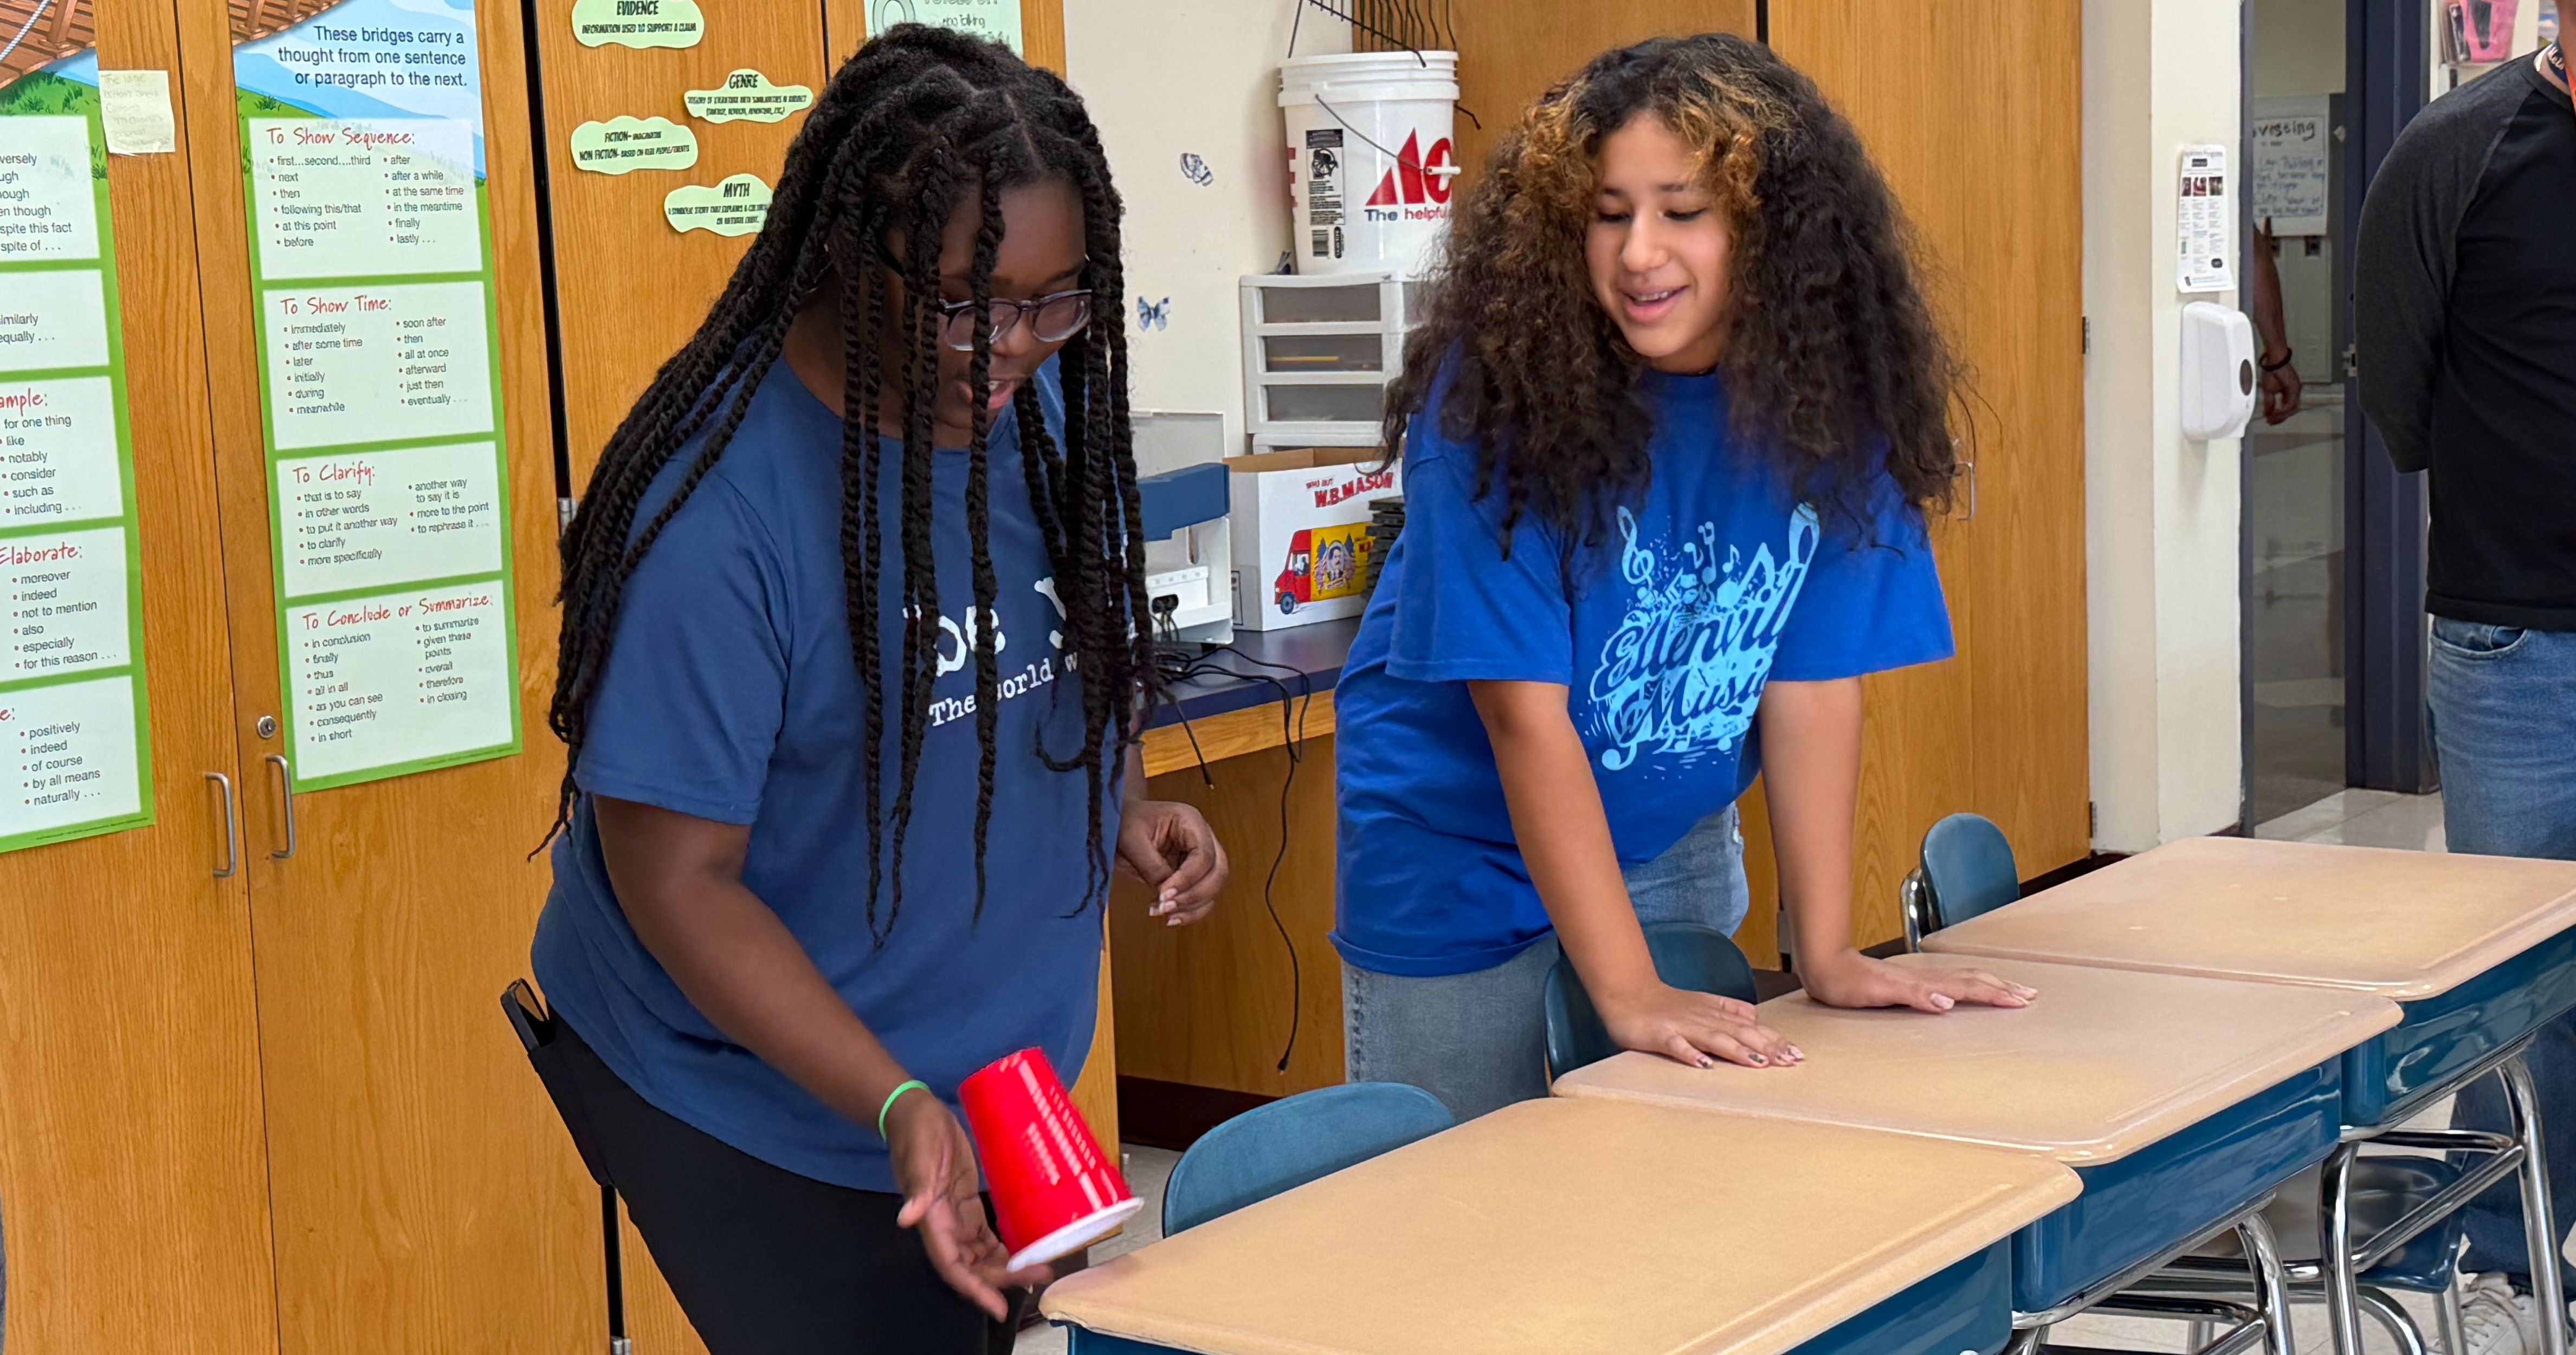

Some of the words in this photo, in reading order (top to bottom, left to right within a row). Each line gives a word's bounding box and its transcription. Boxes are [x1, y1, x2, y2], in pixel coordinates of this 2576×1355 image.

[617, 0, 659, 15] EVIDENCE
[314, 25, 357, 41] These
[362, 28, 414, 45] bridges
[418, 31, 451, 46] carry
[456, 33, 464, 43] a
[278, 47, 334, 66] thought
[338, 48, 370, 63] from
[376, 51, 400, 63] one
[405, 50, 466, 65] sentence
[295, 73, 309, 84] or
[315, 71, 386, 88] paragraph
[391, 72, 404, 85] to
[409, 72, 430, 85] the
[435, 73, 467, 86] next.
[729, 74, 758, 89] GENRE
[267, 127, 284, 144] To
[294, 127, 335, 145] Show
[342, 127, 415, 151] Sequence:
[0, 153, 37, 166] versely
[391, 154, 410, 165] after
[579, 150, 592, 161] NON
[279, 172, 298, 181] next
[392, 171, 410, 180] after
[422, 170, 443, 180] while
[280, 189, 300, 198] then
[393, 187, 401, 196] at
[404, 186, 417, 196] the
[446, 186, 464, 195] time
[724, 183, 750, 197] MYTH
[14, 205, 51, 218] though
[281, 204, 322, 216] following
[325, 203, 361, 213] this/that
[394, 202, 402, 211] in
[404, 202, 417, 211] the
[421, 202, 462, 211] meantime
[1364, 209, 1398, 221] The
[0, 223, 26, 236] spite
[29, 223, 49, 233] this
[51, 222, 72, 232] fact
[282, 222, 291, 231] at
[294, 221, 311, 230] this
[314, 221, 336, 231] point
[396, 217, 420, 229] finally
[284, 237, 314, 247] before
[397, 234, 419, 245] lastly
[1, 241, 27, 254] spite
[30, 240, 41, 250] of
[281, 298, 298, 315] To
[307, 297, 348, 315] Show
[354, 295, 391, 312] Time:
[403, 320, 424, 328] soon
[427, 317, 446, 327] after
[0, 331, 35, 345] equally
[316, 340, 341, 349] some
[343, 338, 363, 347] time
[404, 334, 423, 343] then
[405, 350, 415, 359] all
[417, 350, 425, 358] at
[428, 349, 448, 358] once
[294, 356, 313, 366] later
[406, 363, 446, 374] afterward
[406, 381, 422, 393] just
[425, 380, 443, 389] then
[0, 388, 48, 416] ample:
[408, 394, 450, 405] eventually
[4, 419, 17, 429] for
[22, 418, 42, 428] one
[46, 416, 72, 427] thing
[7, 436, 25, 445] like
[9, 451, 47, 464] notably
[11, 468, 56, 481] consider
[293, 466, 309, 483] To
[319, 461, 375, 486] Clarify:
[415, 481, 447, 491] another
[450, 479, 467, 488] way
[12, 487, 37, 498] such
[41, 487, 54, 496] as
[334, 491, 344, 499] to
[347, 490, 361, 500] say
[416, 494, 425, 503] to
[428, 494, 442, 502] say
[445, 491, 449, 500] it
[453, 490, 459, 498] is
[14, 502, 62, 515] including
[306, 509, 313, 518] in
[342, 503, 369, 514] words
[417, 509, 439, 518] more
[441, 507, 449, 515] to
[453, 505, 465, 514] the
[468, 502, 489, 514] point
[307, 526, 315, 534] to
[318, 523, 333, 534] put
[336, 522, 341, 530] it
[344, 519, 378, 529] another
[380, 517, 397, 527] way
[418, 525, 426, 533] to
[468, 519, 473, 527] it
[308, 541, 316, 549] to
[0, 541, 82, 565] Elaborate:
[21, 571, 70, 584] moreover
[22, 588, 57, 601] indeed
[22, 607, 38, 618] not
[43, 607, 52, 616] to
[56, 601, 97, 614] mention
[303, 612, 318, 630] To
[328, 604, 390, 626] Conclude
[398, 605, 412, 617] or
[419, 591, 493, 615] Summarize:
[22, 625, 44, 635] also
[423, 624, 431, 632] to
[23, 637, 74, 653] especially
[312, 639, 320, 648] in
[24, 659, 37, 669] for
[41, 657, 60, 667] this
[63, 652, 98, 664] reason
[328, 685, 335, 693] in
[339, 682, 348, 692] all
[929, 695, 976, 727] The
[997, 658, 1054, 701] orld
[330, 700, 346, 711] you
[348, 696, 365, 705] can
[367, 693, 383, 702] see
[427, 695, 434, 704] in
[317, 709, 377, 727] consequently
[29, 722, 80, 740] positively
[318, 733, 326, 742] in
[330, 729, 352, 740] short
[31, 740, 67, 755] indeed
[31, 761, 42, 771] of
[46, 756, 82, 769] course
[33, 779, 46, 790] by
[49, 775, 61, 786] all
[65, 770, 100, 783] means
[34, 789, 80, 805] naturally
